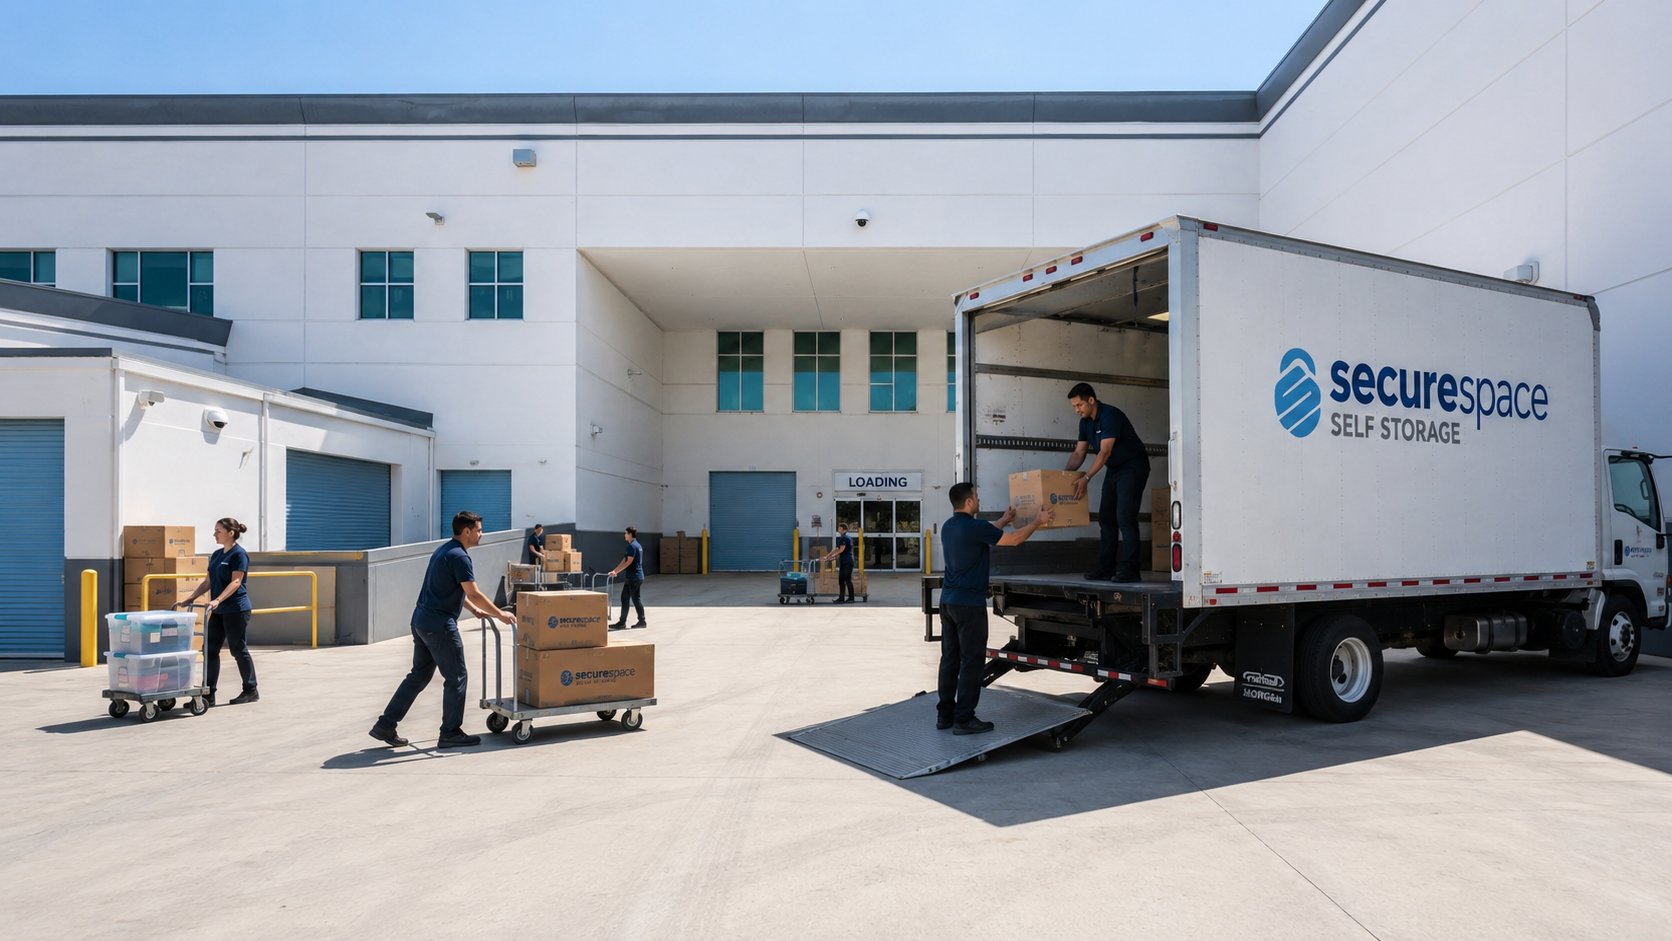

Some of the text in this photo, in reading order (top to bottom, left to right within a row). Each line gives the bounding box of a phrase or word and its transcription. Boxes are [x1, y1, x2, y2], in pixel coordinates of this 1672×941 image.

[1329, 360, 1549, 430] securespace
[1331, 412, 1461, 444] SELF STORAGE
[849, 477, 908, 488] LOADING
[575, 668, 635, 680] securespace
